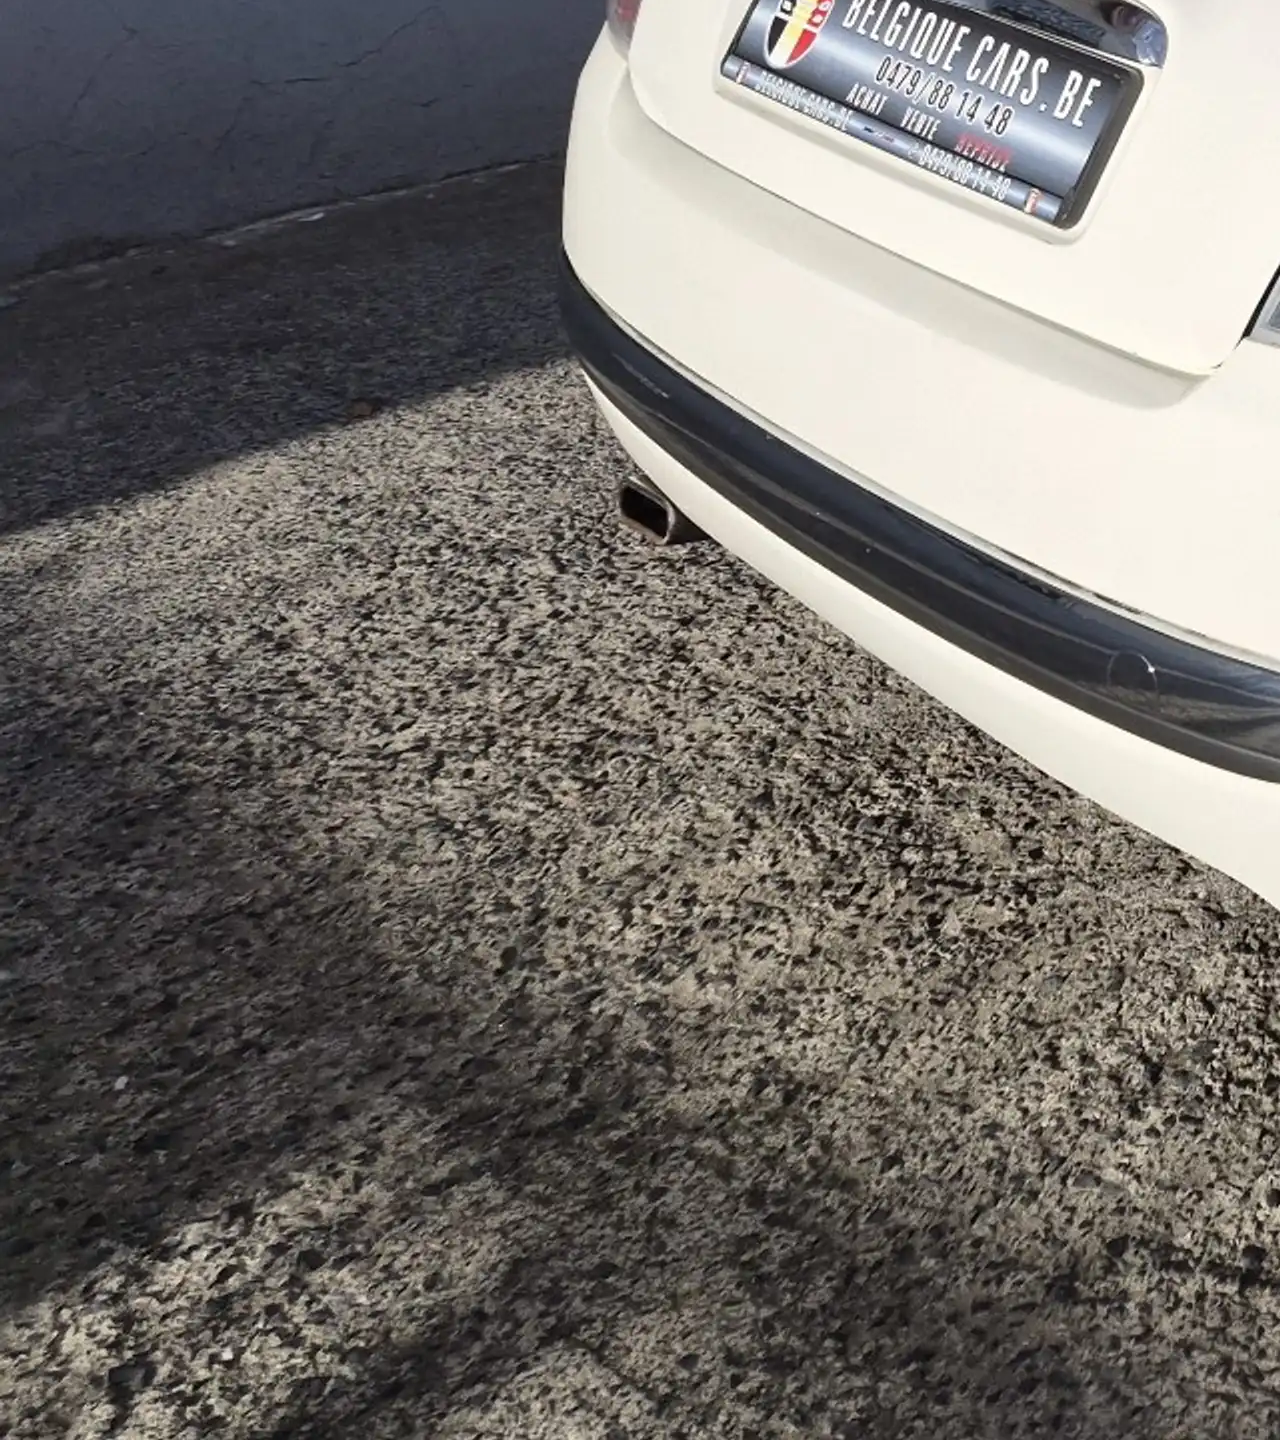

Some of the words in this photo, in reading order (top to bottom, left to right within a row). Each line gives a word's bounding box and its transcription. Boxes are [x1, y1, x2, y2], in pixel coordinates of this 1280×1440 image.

[845, 82, 889, 116] ACHAT
[899, 106, 942, 140] VENTE
[875, 55, 955, 112] 0479/88
[955, 89, 985, 124] 14
[984, 102, 1014, 137] 48
